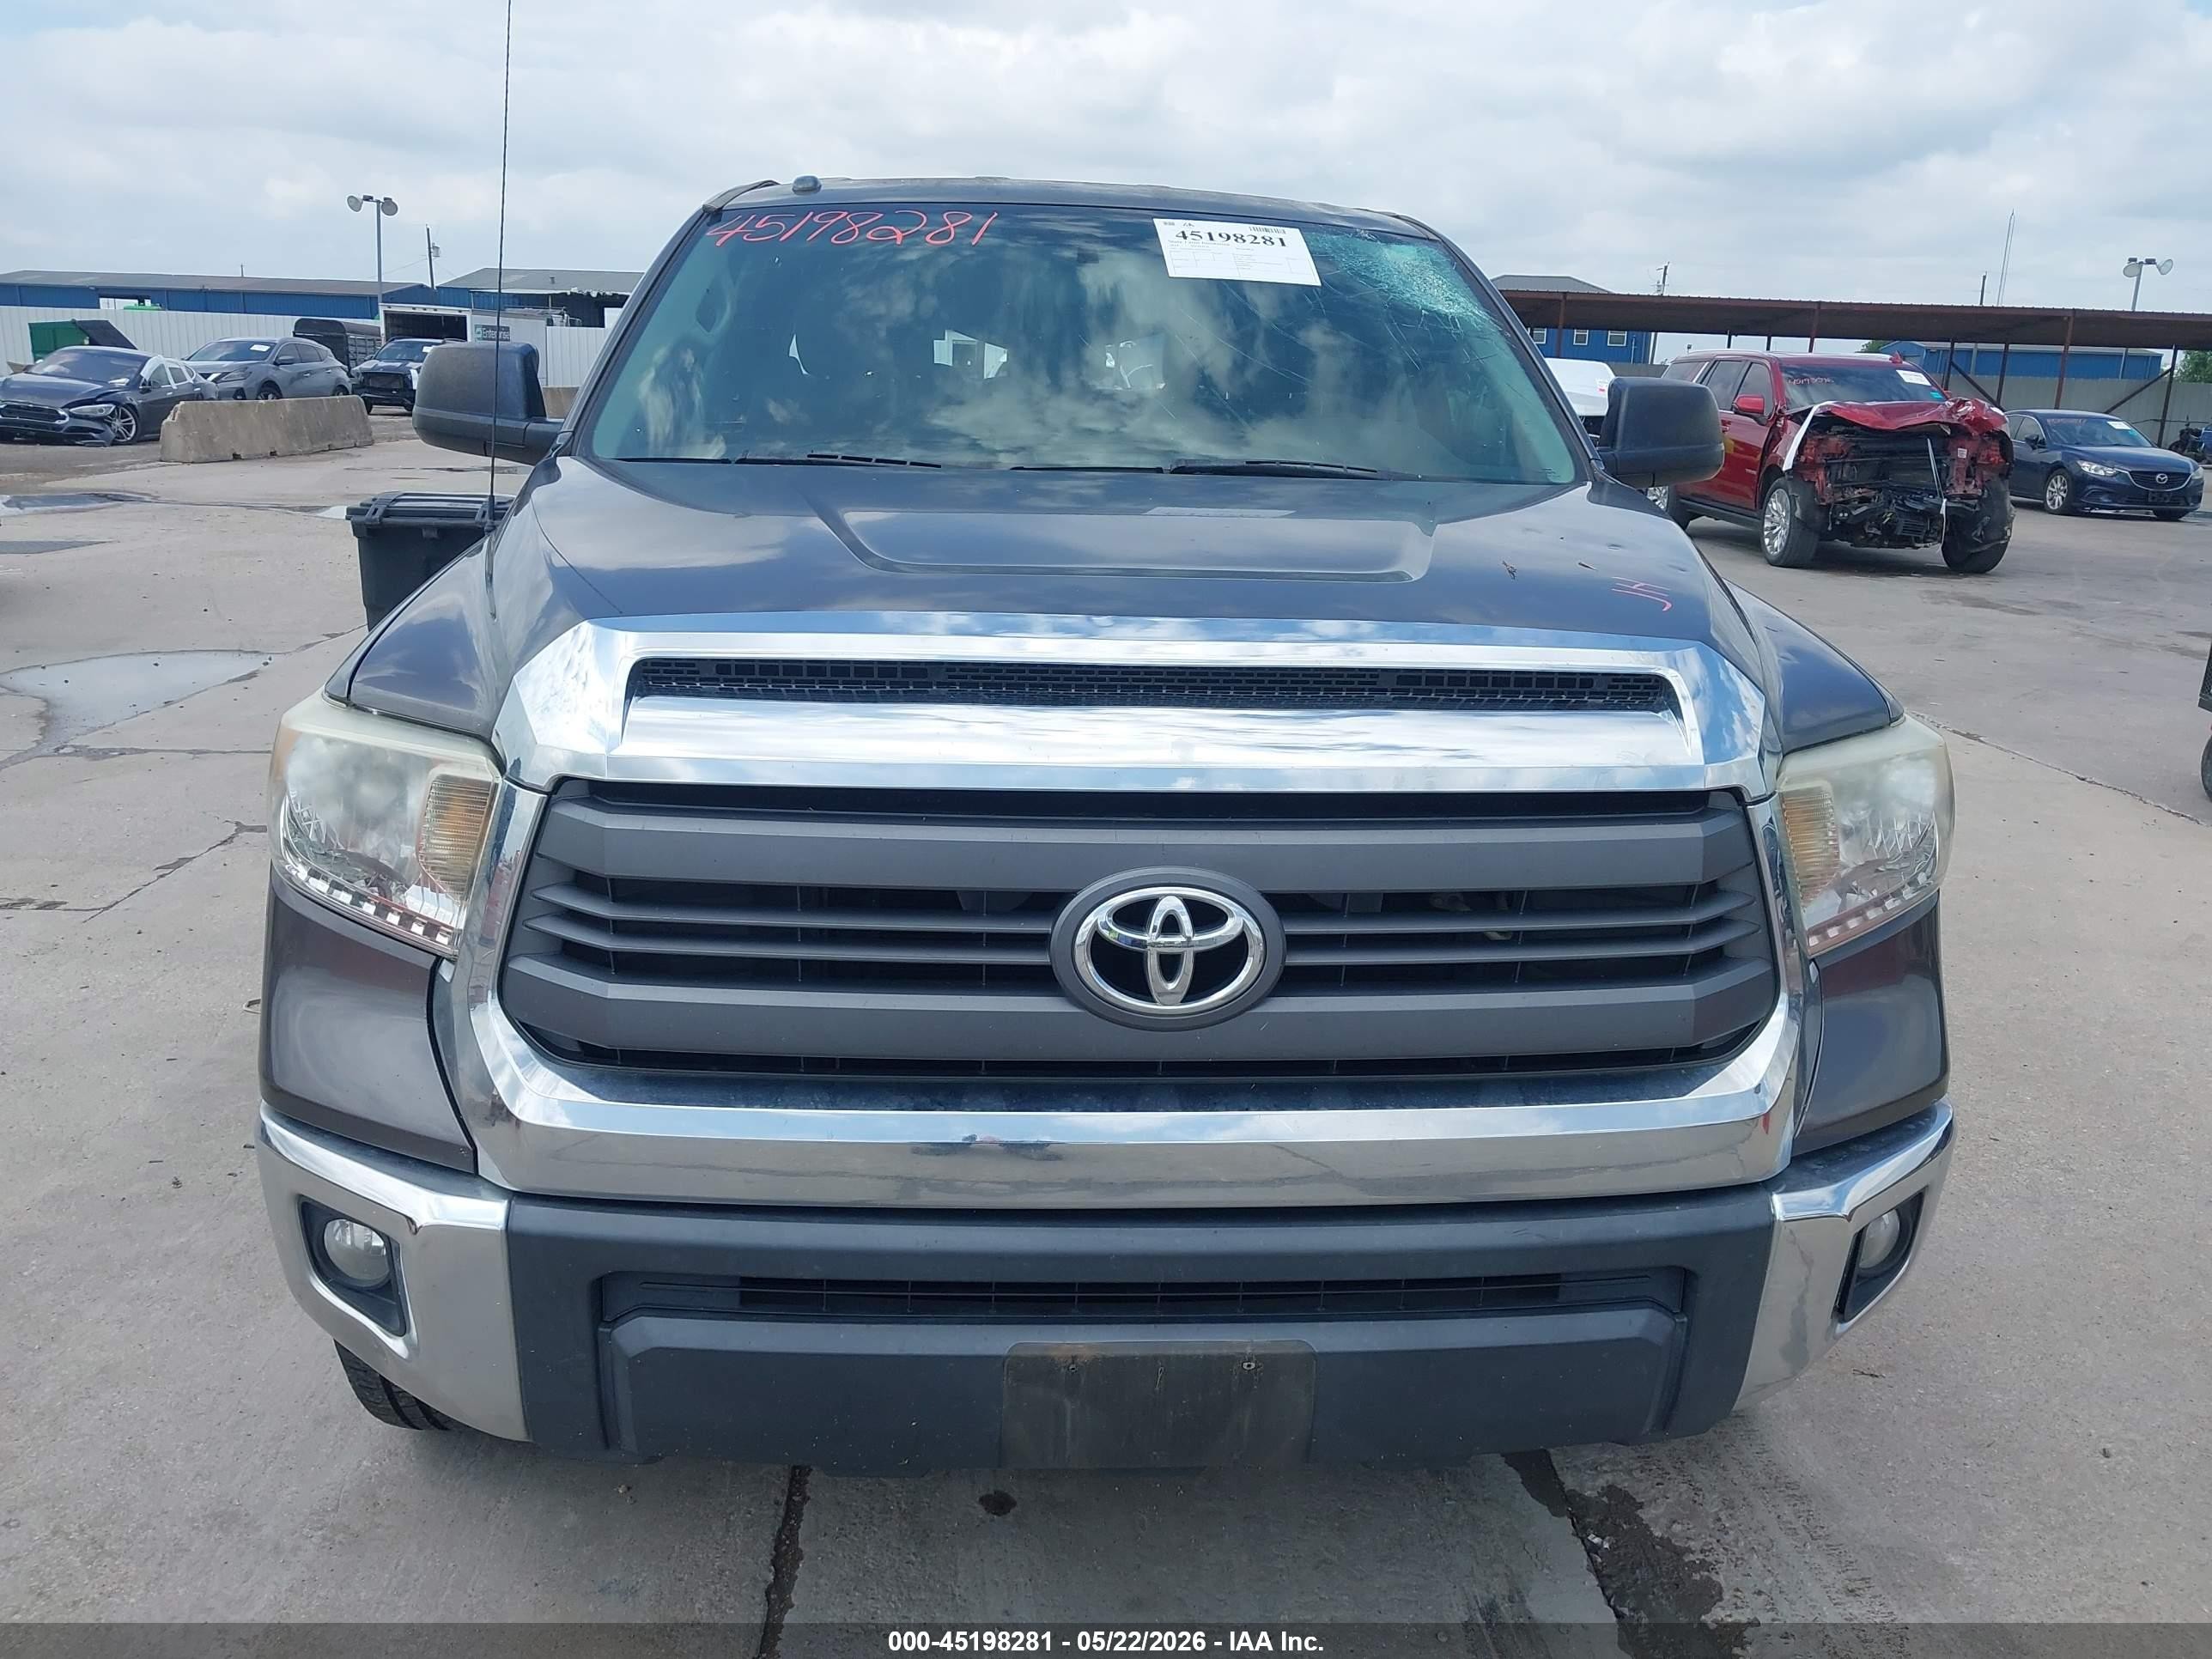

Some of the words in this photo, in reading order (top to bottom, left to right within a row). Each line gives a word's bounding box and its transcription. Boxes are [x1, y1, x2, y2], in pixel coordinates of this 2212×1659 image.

[706, 210, 999, 246] 45198281
[1175, 229, 1287, 247] 45198281
[483, 327, 510, 339] Enterrise
